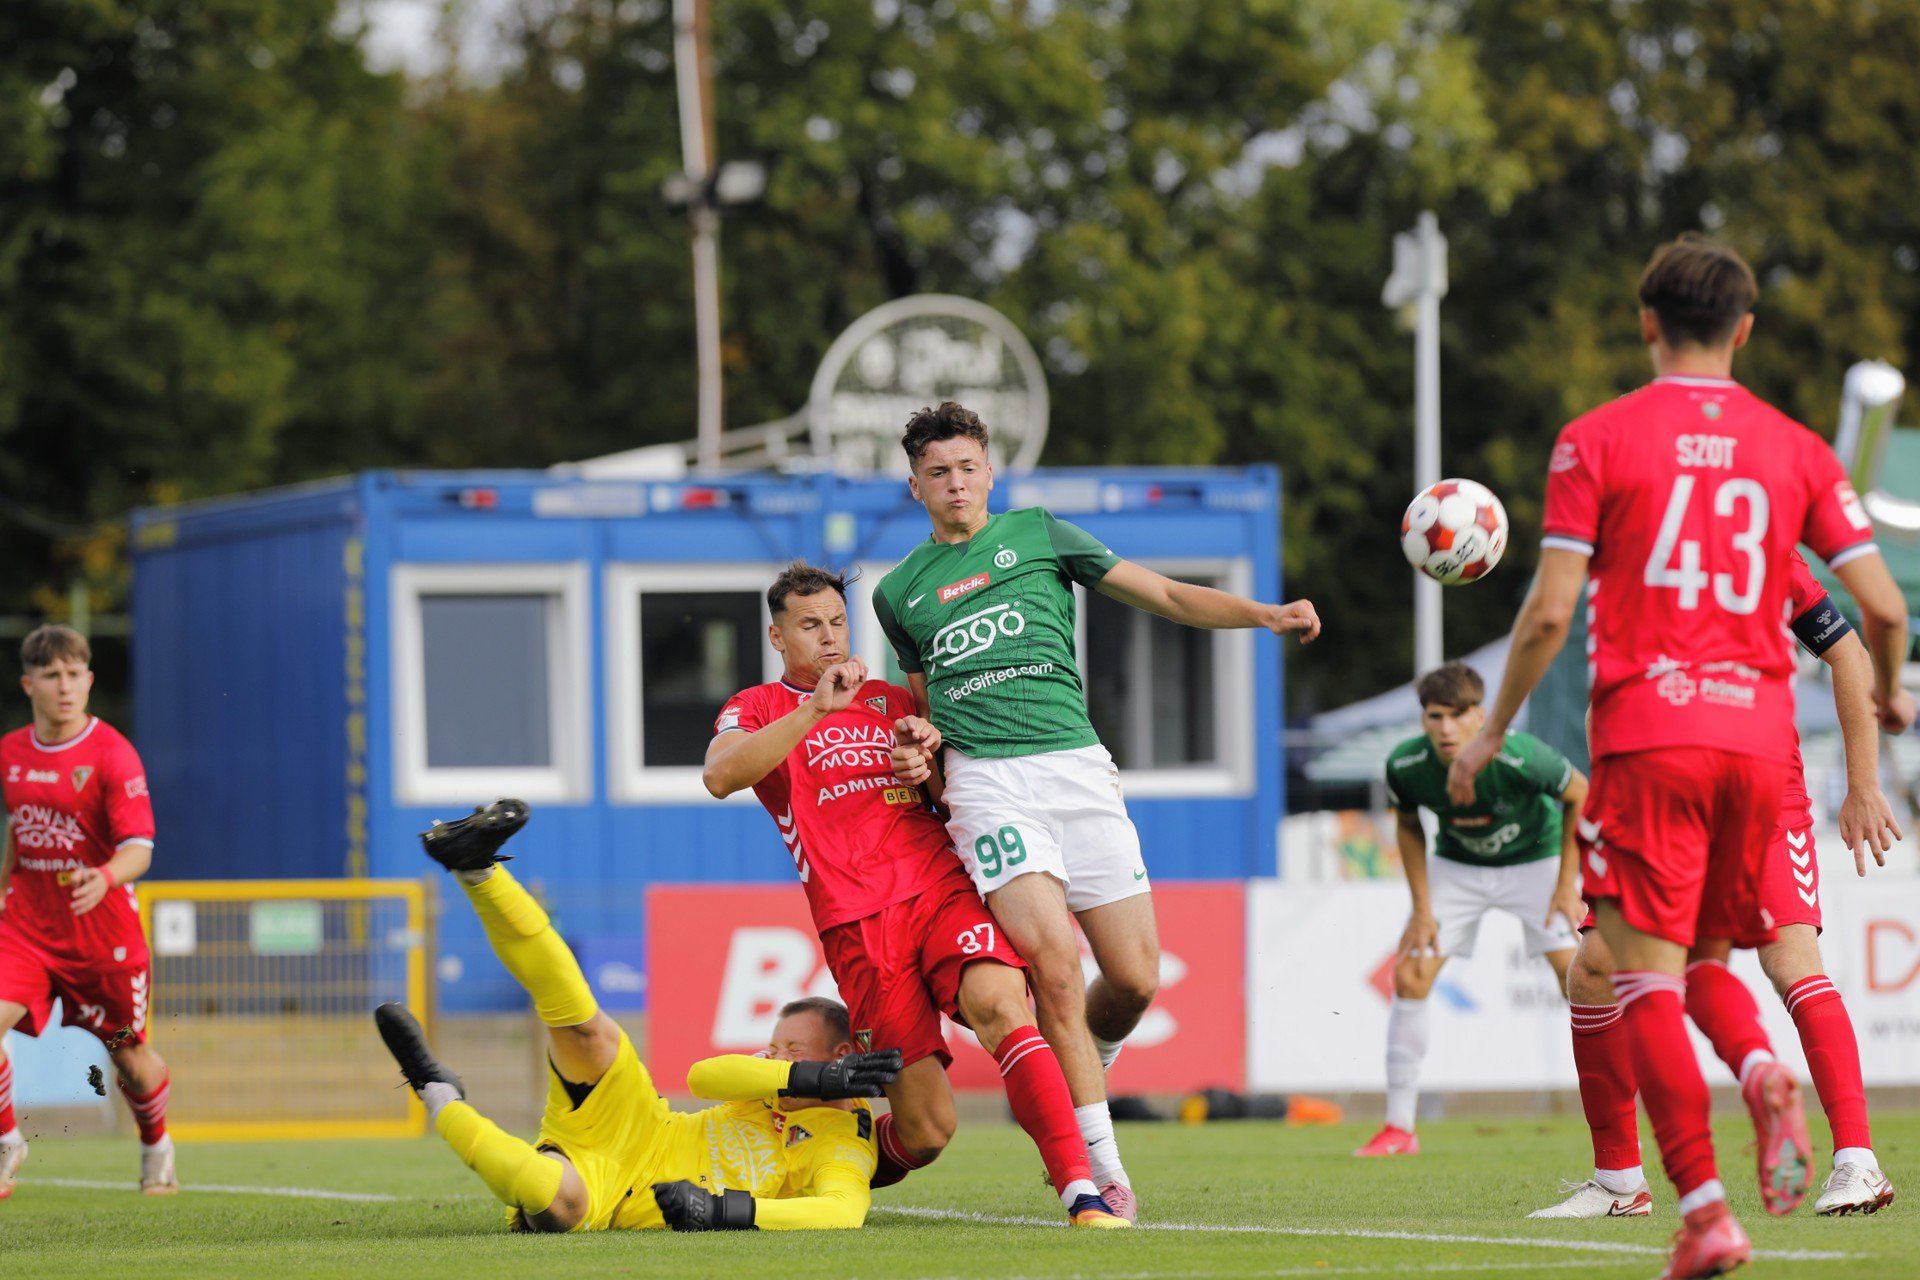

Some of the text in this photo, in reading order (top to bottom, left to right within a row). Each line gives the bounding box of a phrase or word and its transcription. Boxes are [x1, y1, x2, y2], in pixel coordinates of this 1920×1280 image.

[1676, 434, 1738, 469] SZOT
[1643, 474, 1770, 615] 43
[943, 575, 986, 600] Betclic
[944, 662, 1053, 702] TedGifted.com
[817, 776, 906, 807] ADMIRA
[975, 826, 1027, 878] 99
[956, 922, 995, 955] 37
